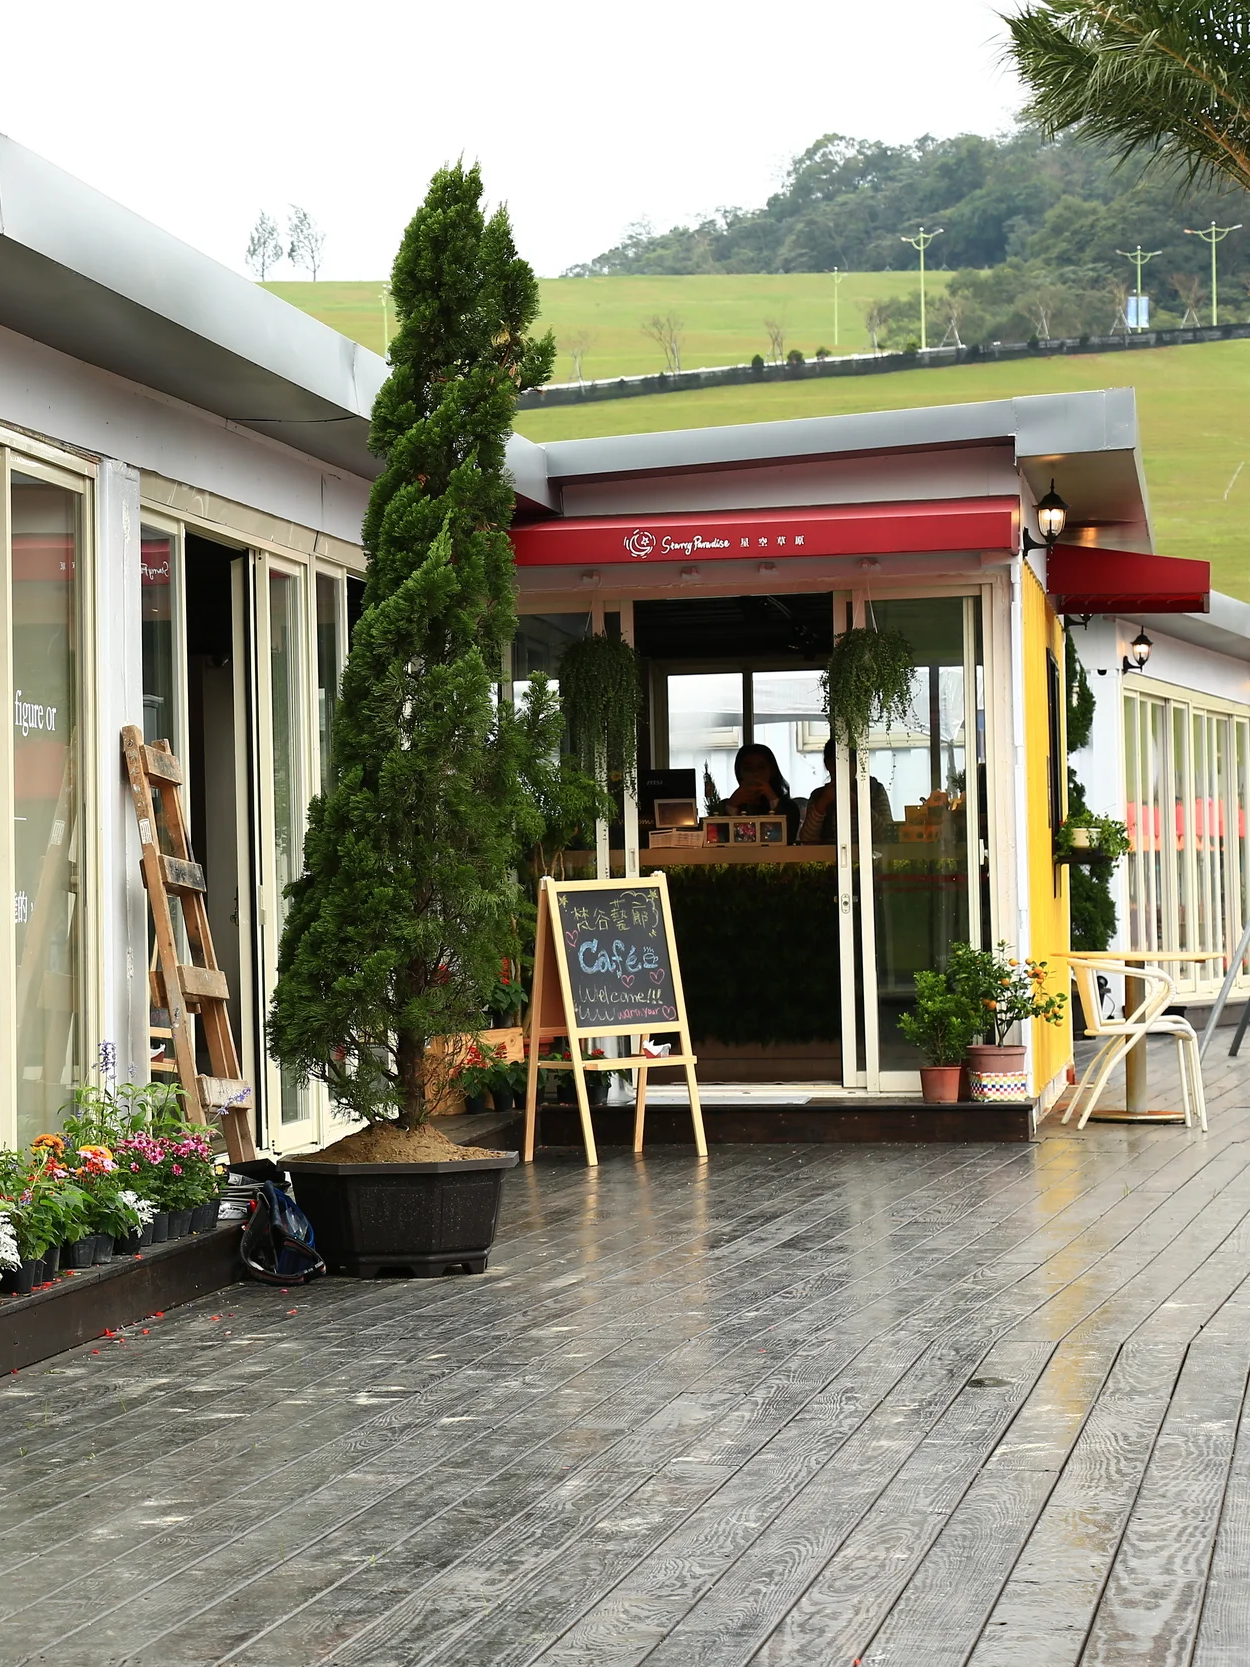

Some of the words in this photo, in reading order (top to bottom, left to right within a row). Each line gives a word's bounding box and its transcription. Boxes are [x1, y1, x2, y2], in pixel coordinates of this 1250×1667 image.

[661, 535, 692, 555] Starry
[693, 535, 731, 551] Paradise
[14, 689, 44, 737] figure
[46, 706, 58, 732] or
